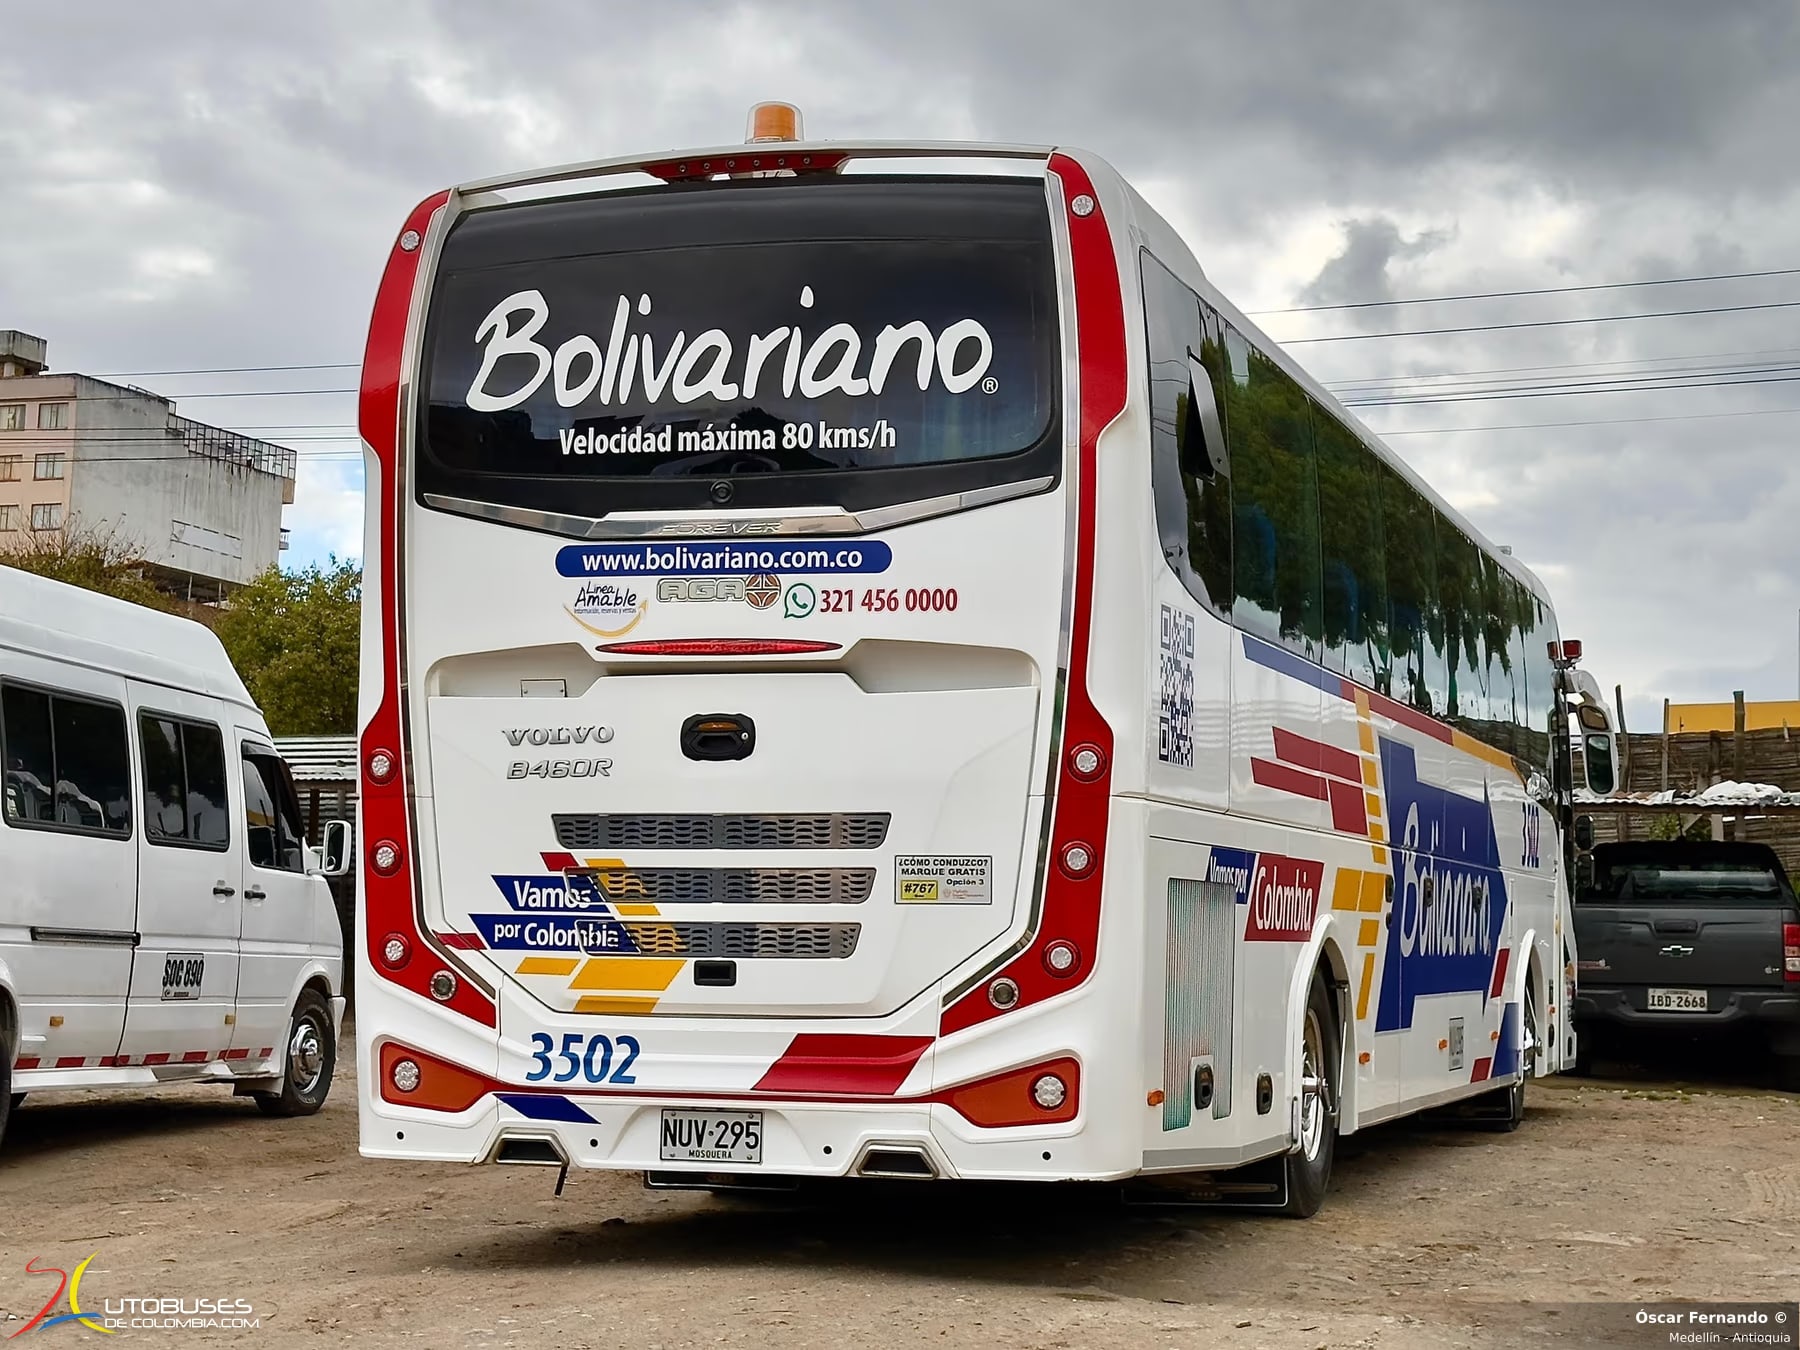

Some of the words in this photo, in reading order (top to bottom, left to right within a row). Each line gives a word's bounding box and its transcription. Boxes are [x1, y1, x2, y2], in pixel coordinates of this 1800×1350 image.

[466, 286, 993, 412] Bolivariano
[559, 425, 671, 455] Velocidad
[678, 423, 776, 451] máxima
[782, 422, 814, 449] 80
[819, 420, 896, 449] kms/h
[659, 522, 783, 534] FOREVER
[582, 546, 863, 571] www.bolivariano.com.co
[574, 586, 637, 607] Amable
[657, 578, 746, 602] AGA
[820, 589, 854, 612] 321
[861, 589, 899, 612] 456
[905, 588, 958, 612] 0000
[502, 725, 615, 746] VOLVO
[507, 758, 613, 779] B460R
[898, 857, 930, 866] ¿CÓMO
[514, 880, 592, 908] Vamos
[904, 883, 935, 893] #767
[946, 878, 976, 886] Opción
[1255, 866, 1313, 932] Colombia
[495, 924, 521, 942] por
[524, 922, 619, 947] Colombia
[184, 959, 204, 987] 890
[1650, 995, 1705, 1008] IBD-2668
[526, 1032, 640, 1084] 3502
[689, 1149, 732, 1159] MOSQUERA
